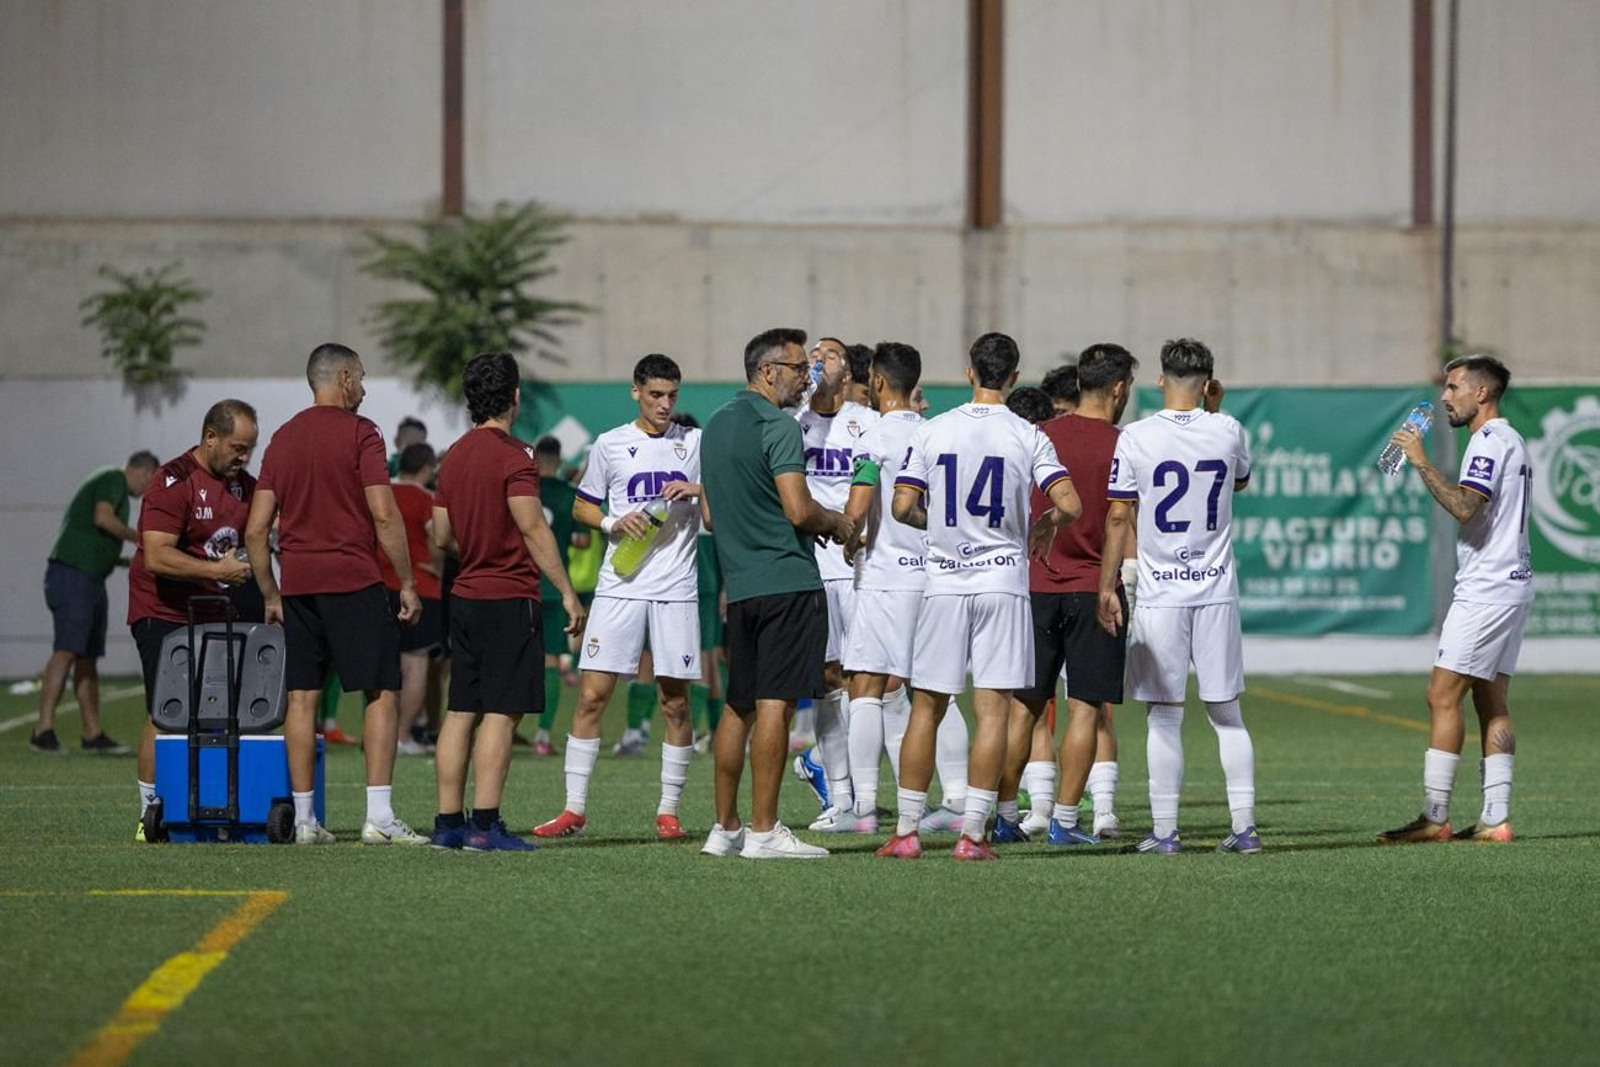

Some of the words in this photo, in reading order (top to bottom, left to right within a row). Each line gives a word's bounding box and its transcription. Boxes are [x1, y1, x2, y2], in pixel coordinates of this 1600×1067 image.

[936, 453, 1005, 528] 14
[1153, 459, 1228, 533] 27
[898, 556, 927, 567] cal
[1263, 541, 1400, 570] VIDRIO
